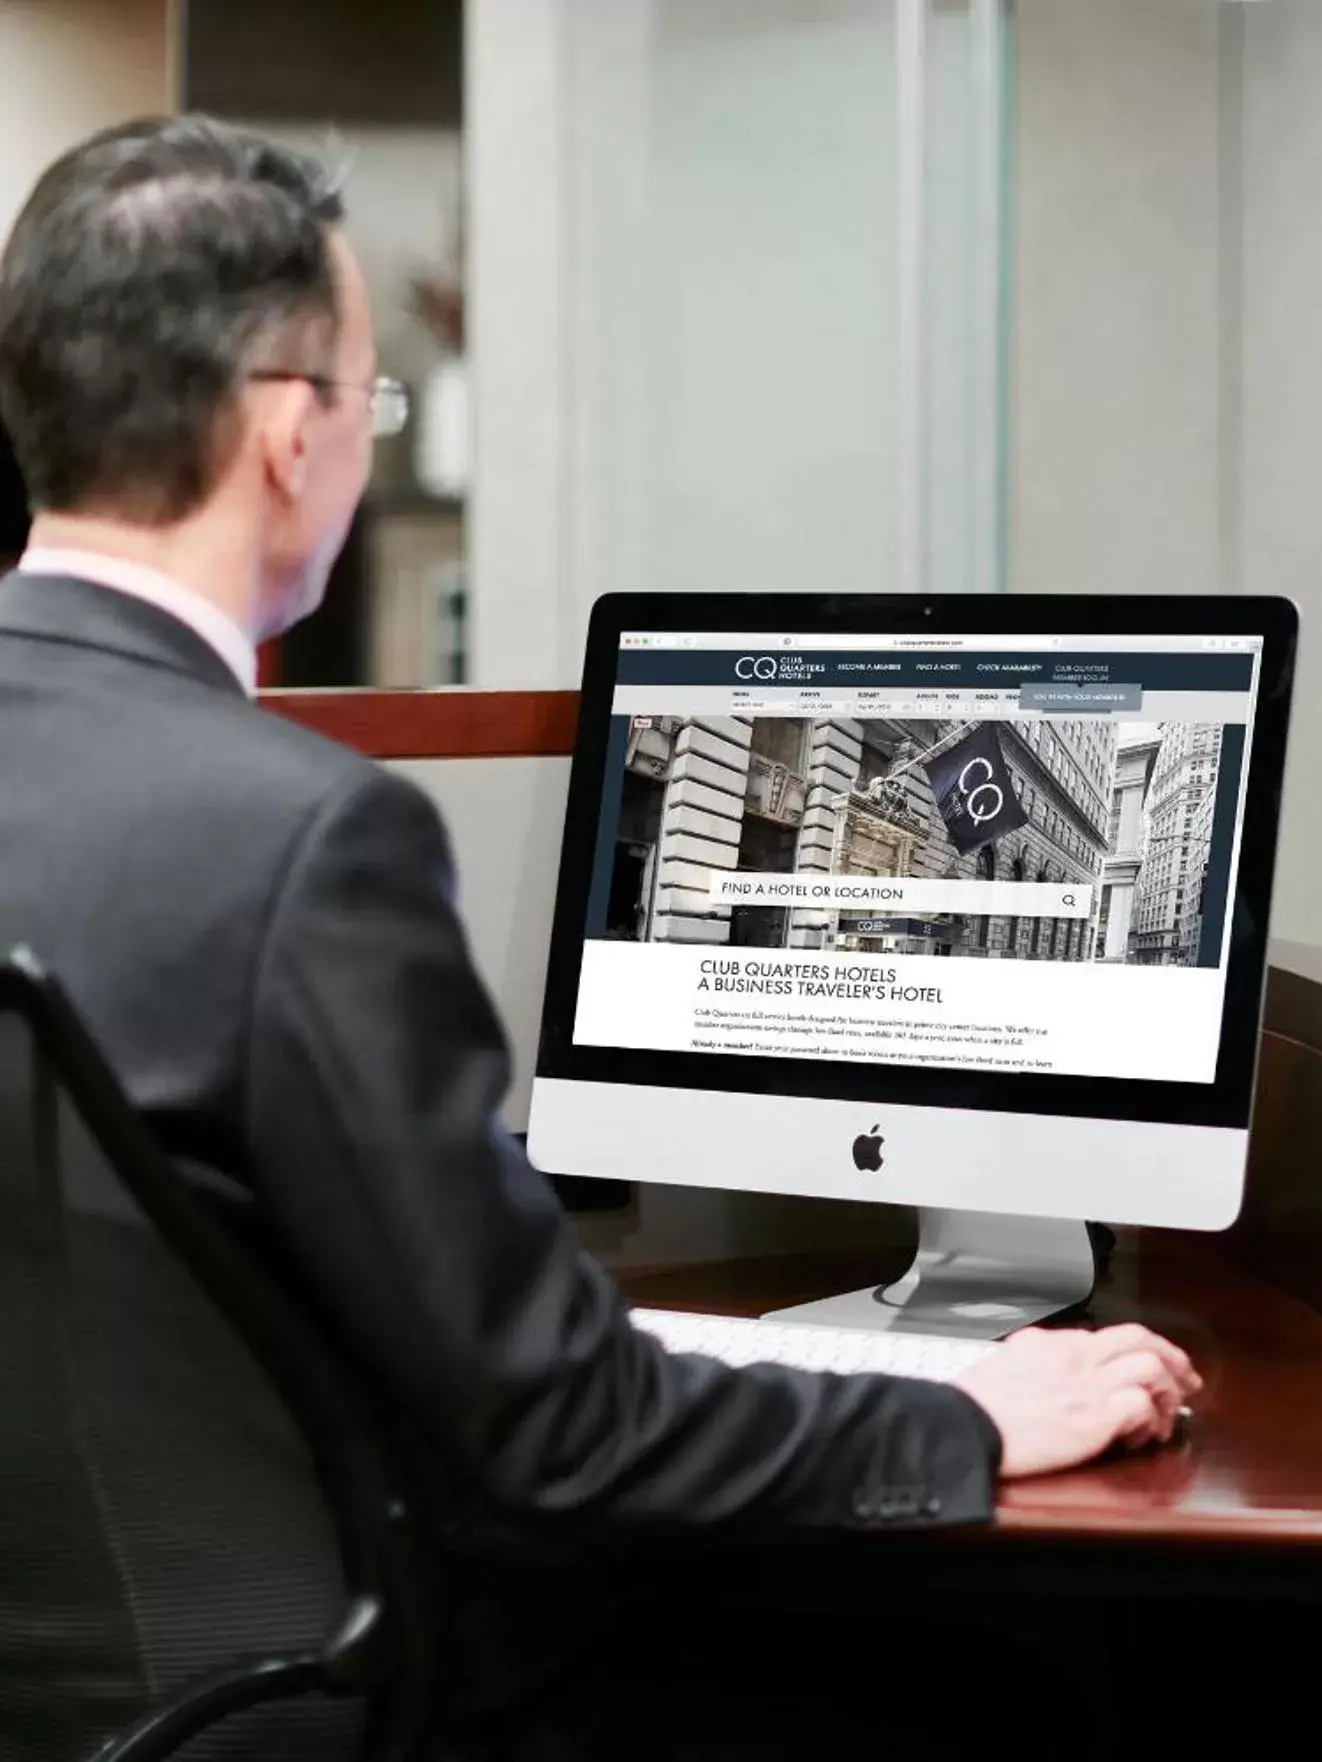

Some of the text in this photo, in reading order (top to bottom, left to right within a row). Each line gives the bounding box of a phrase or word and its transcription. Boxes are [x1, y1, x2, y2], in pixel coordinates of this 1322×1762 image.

[735, 656, 777, 679] CQ
[780, 656, 802, 664] CLUB
[780, 663, 826, 673] QUARTERS
[778, 672, 812, 680] HOTELS
[721, 882, 904, 900] FIND A HOTEL OR LOCATION
[700, 959, 897, 983] CLUB QUARTERS HOTELS
[697, 977, 944, 1004] A BUSINESS TRAVELER'S HOTEL
